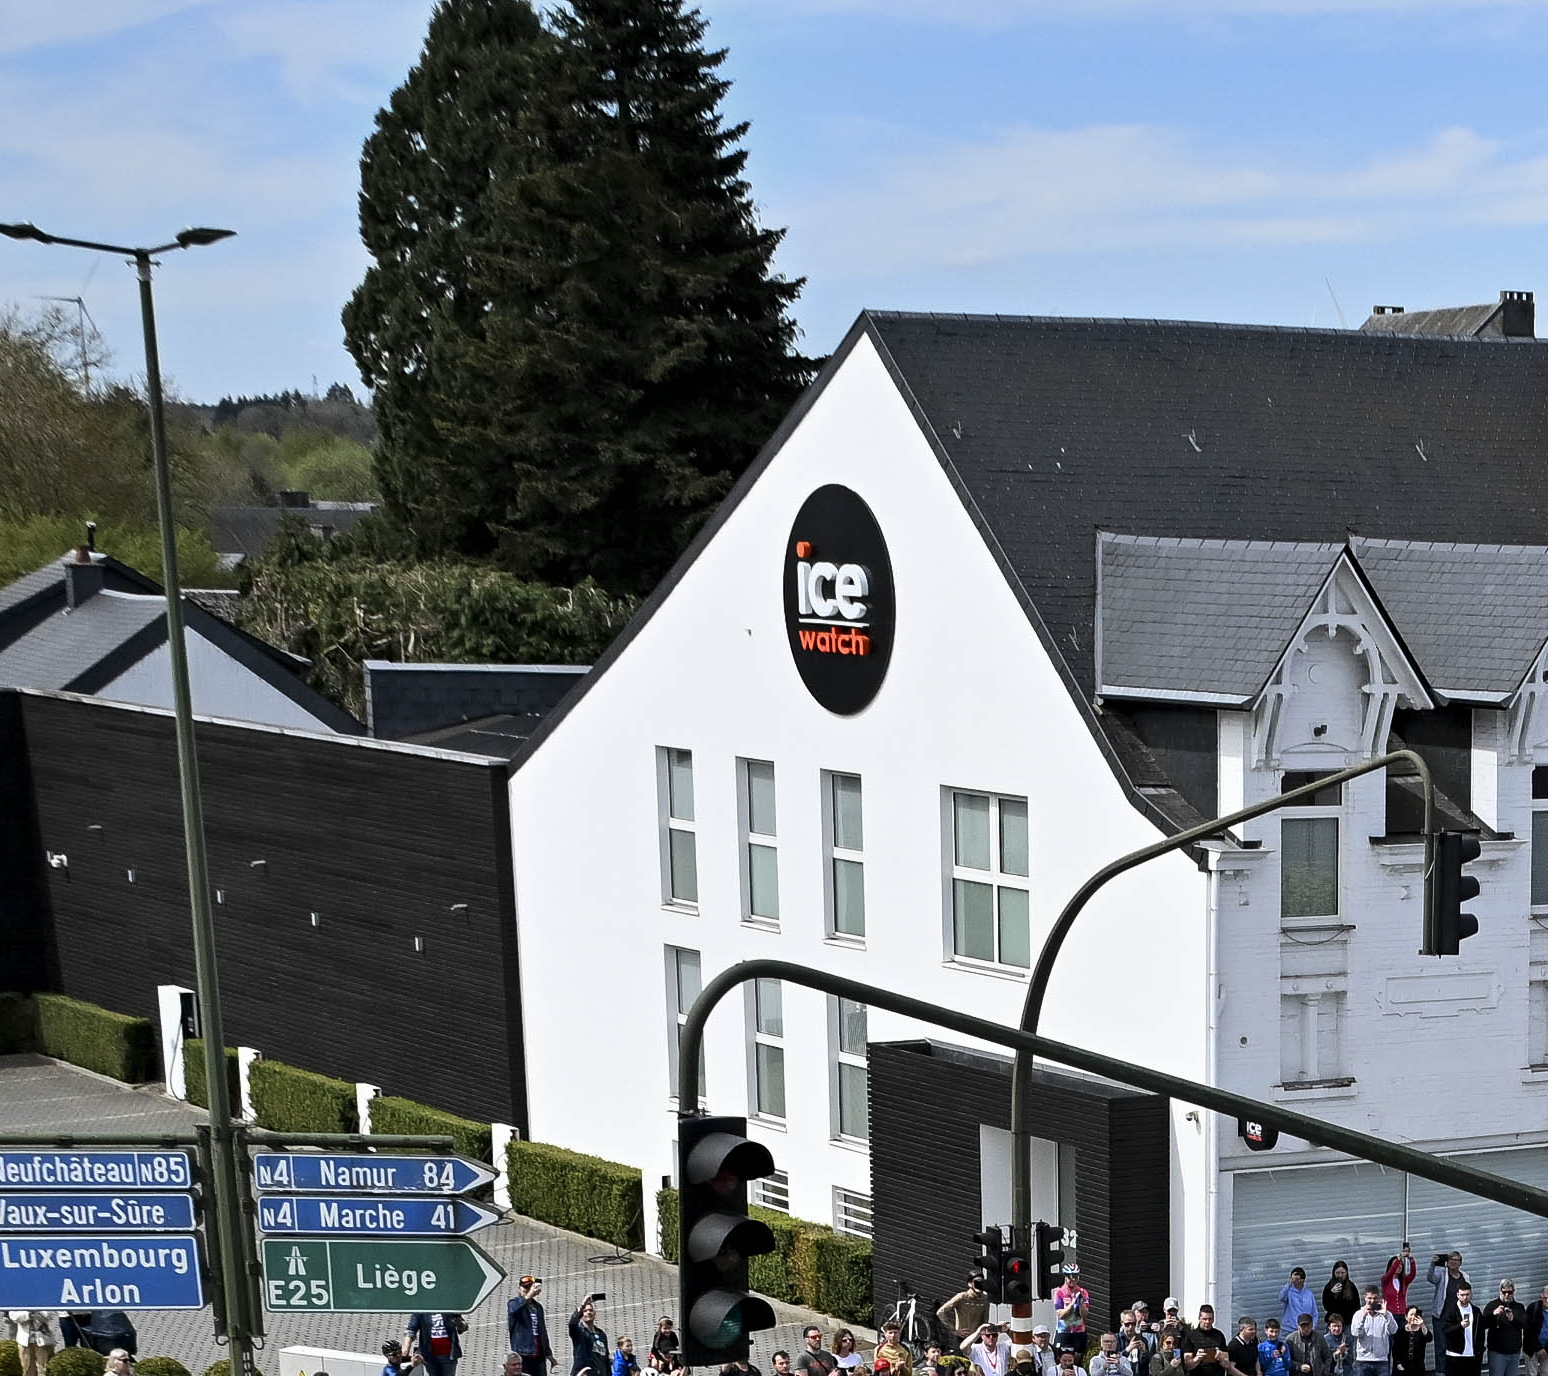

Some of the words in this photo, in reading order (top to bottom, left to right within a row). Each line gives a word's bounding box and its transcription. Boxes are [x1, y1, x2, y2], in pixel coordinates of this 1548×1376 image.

[796, 541, 869, 619] ice
[799, 627, 870, 655] watch
[140, 1157, 186, 1184] N85
[259, 1160, 290, 1185] N4
[320, 1160, 397, 1187] Namur
[422, 1161, 455, 1189] 84
[262, 1202, 292, 1228] N4
[319, 1202, 405, 1229] Marche
[431, 1204, 455, 1230] 41
[1, 1242, 189, 1275] Luxembourg
[60, 1278, 141, 1305] Arlon
[268, 1280, 330, 1306] E25
[356, 1263, 437, 1296] Liège
